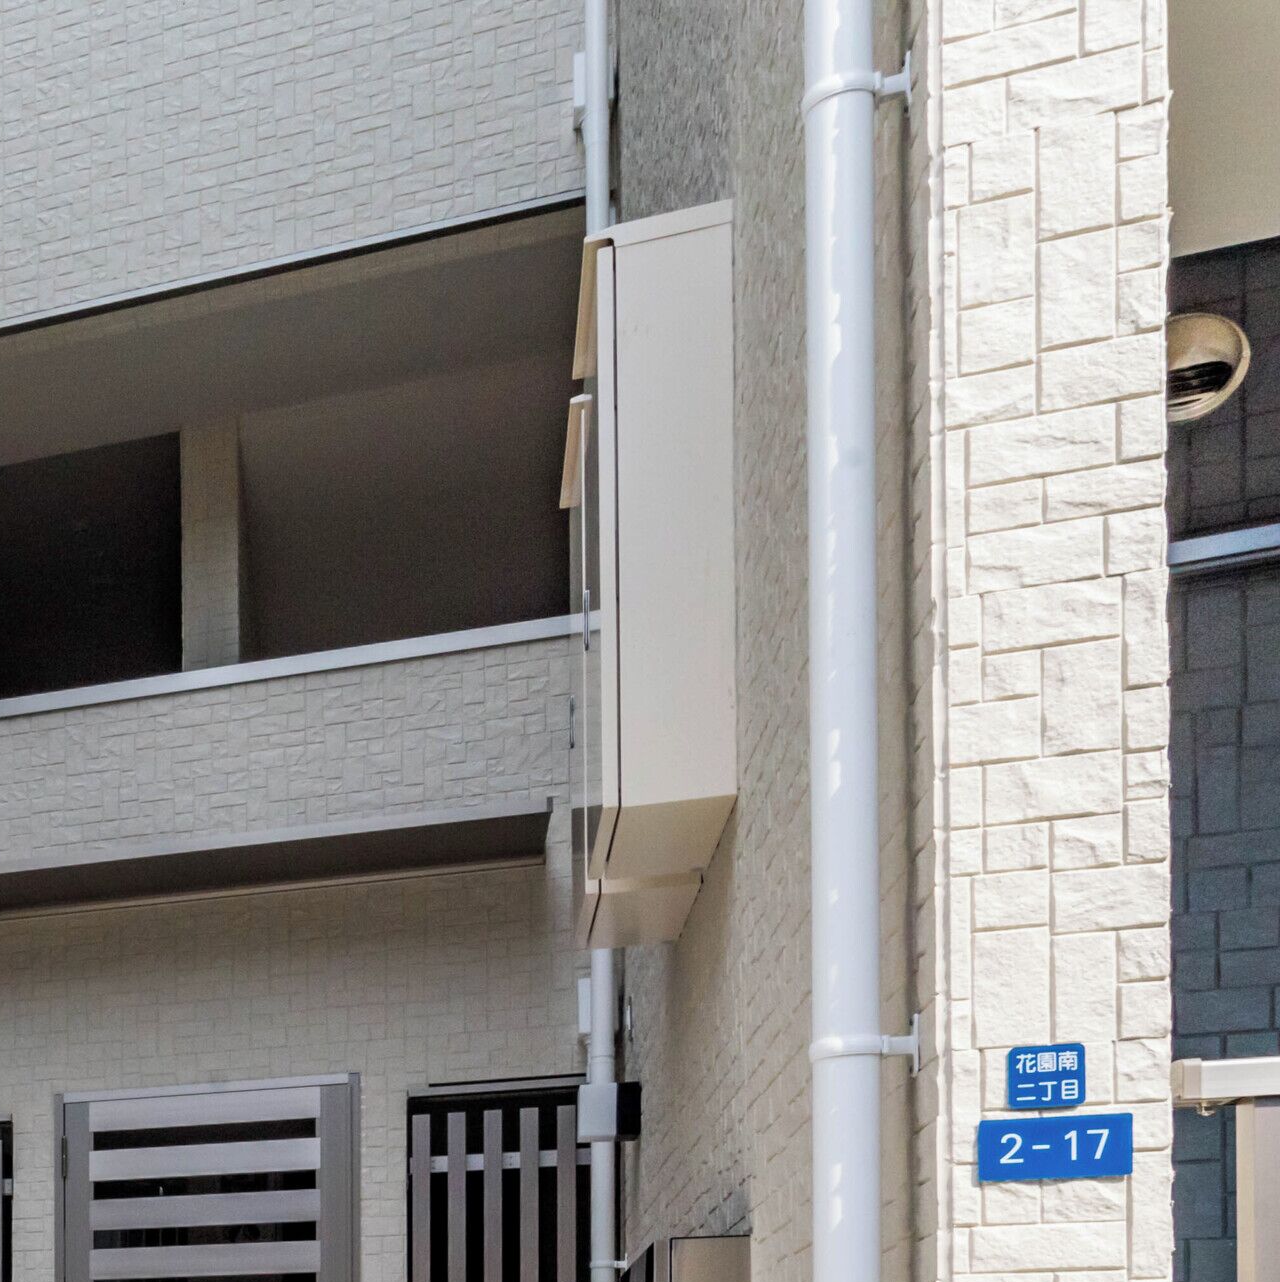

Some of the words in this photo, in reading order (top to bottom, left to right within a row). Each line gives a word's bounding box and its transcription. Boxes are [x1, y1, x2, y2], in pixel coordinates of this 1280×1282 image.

[1015, 1051, 1078, 1074] 花園南
[1016, 1079, 1078, 1102] 二丁目
[999, 1128, 1110, 1165] 2-17
